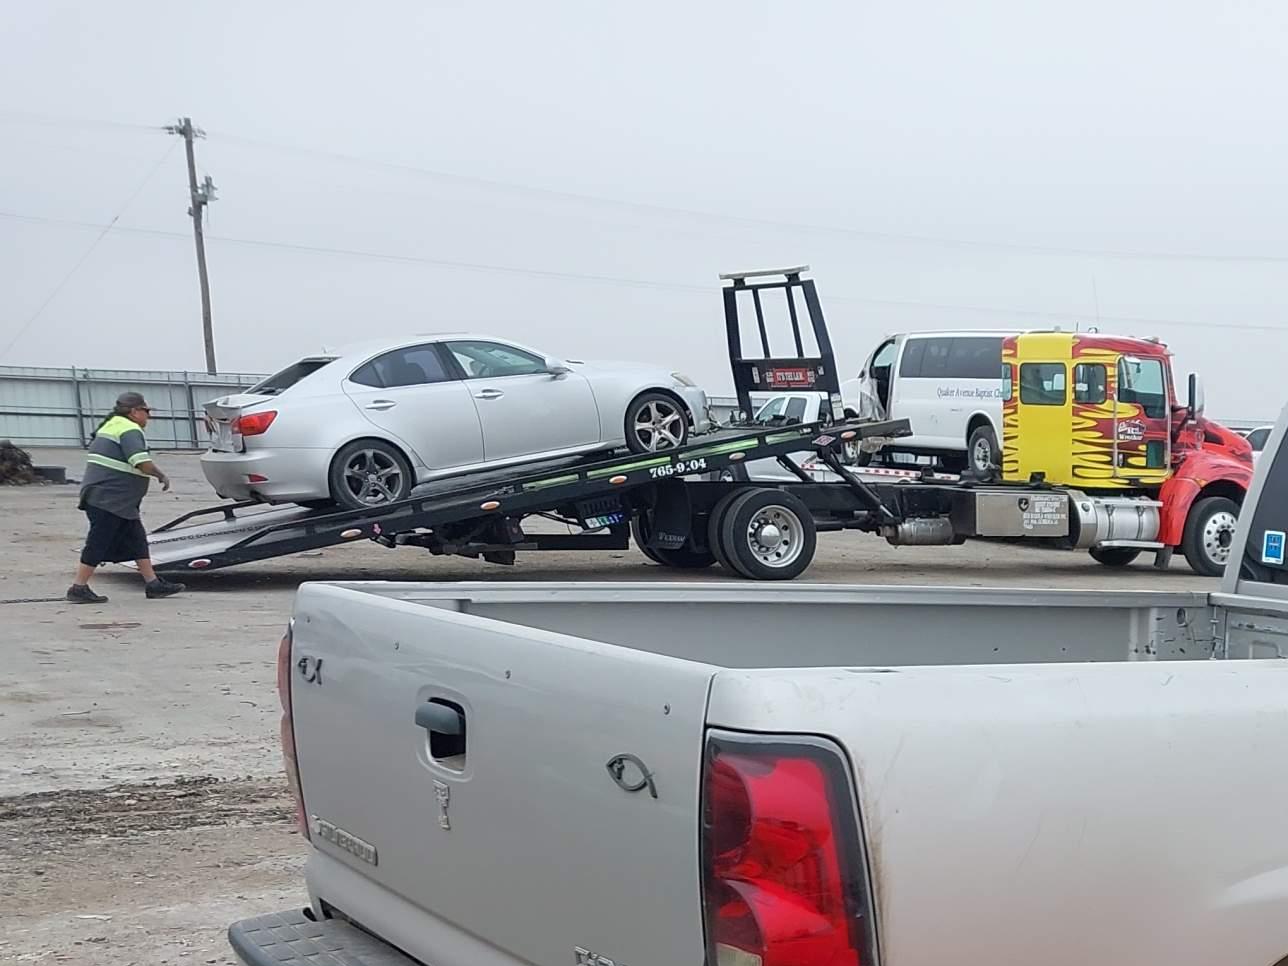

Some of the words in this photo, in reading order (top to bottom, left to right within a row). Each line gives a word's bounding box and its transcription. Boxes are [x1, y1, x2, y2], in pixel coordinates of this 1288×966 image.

[936, 386, 955, 399] Quaker
[955, 387, 975, 398] Avenue
[976, 387, 993, 400] Baptist
